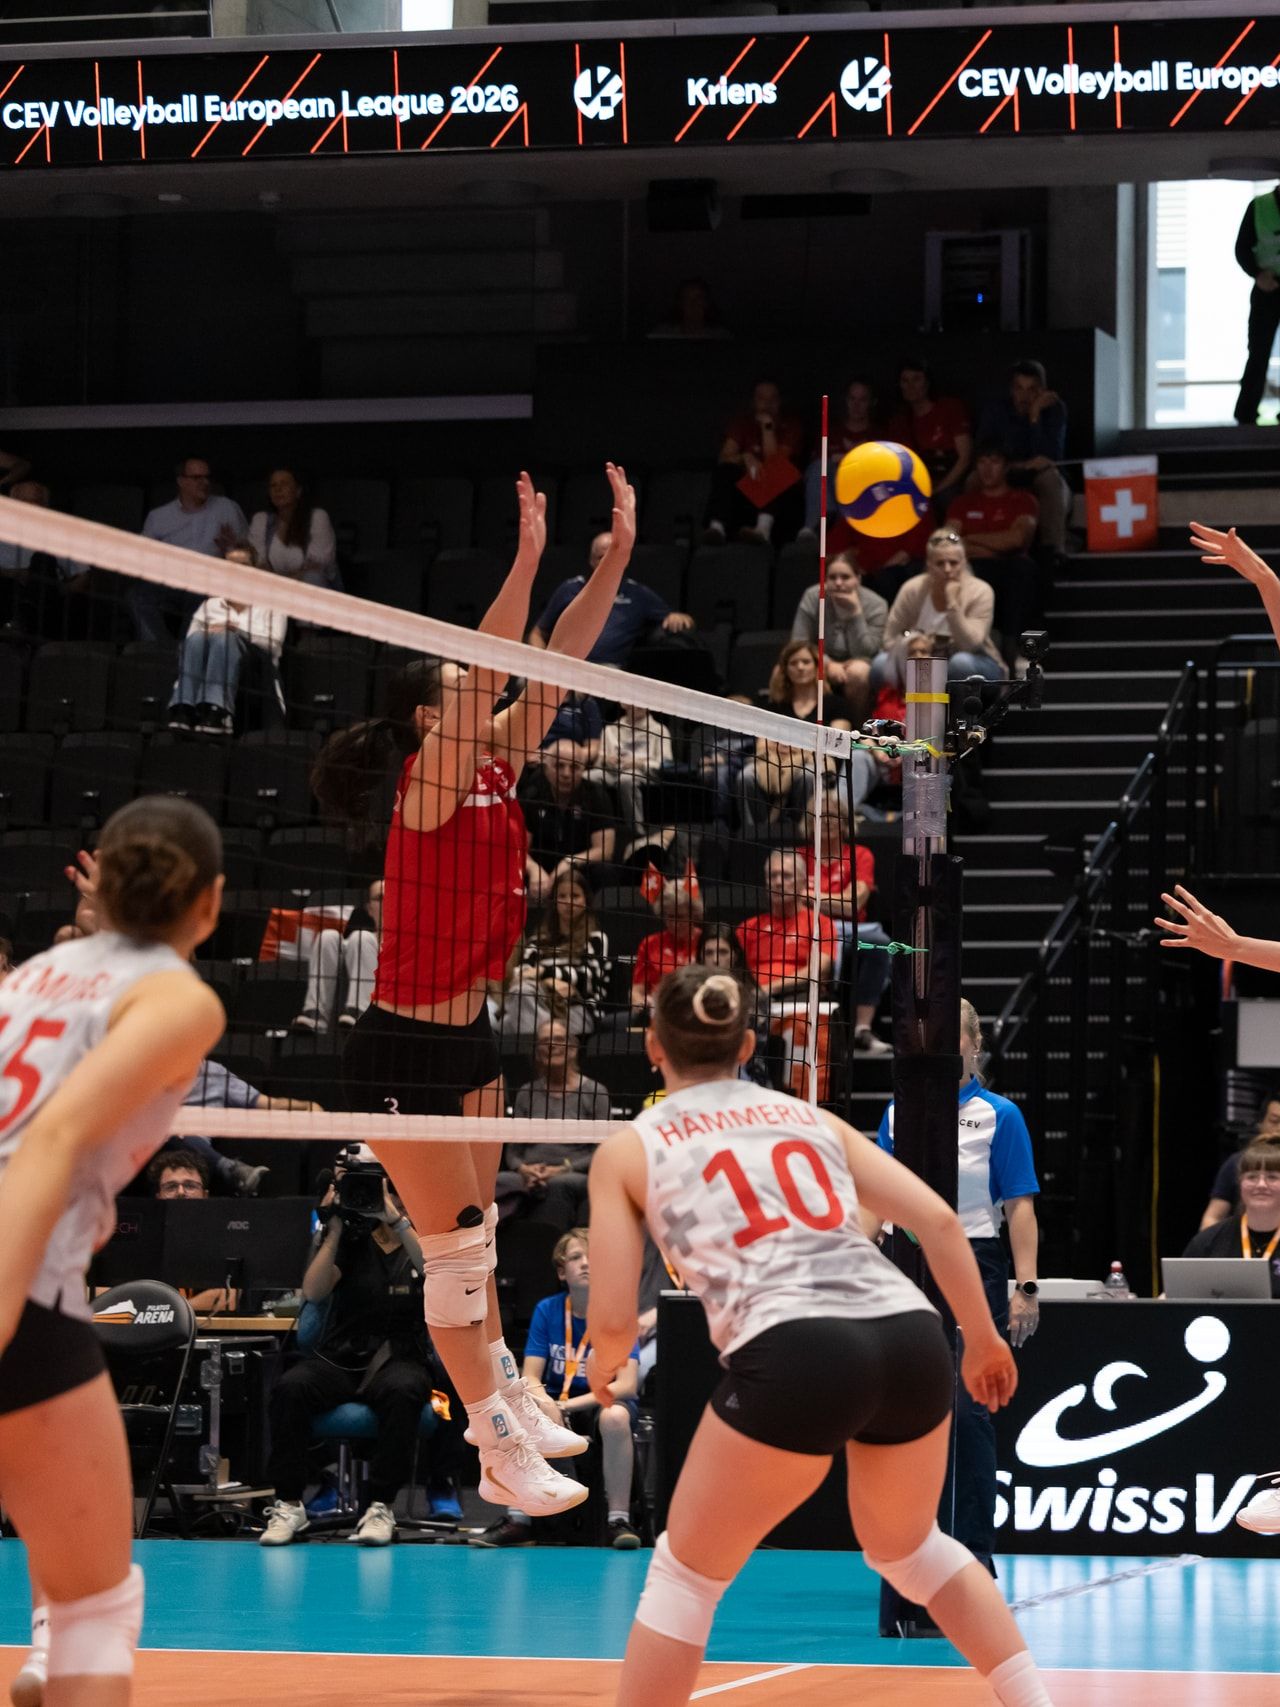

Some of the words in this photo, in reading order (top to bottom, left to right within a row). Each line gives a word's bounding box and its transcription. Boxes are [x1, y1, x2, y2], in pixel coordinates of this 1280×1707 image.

[687, 75, 778, 106] Kriens
[958, 68, 1021, 98] CEV
[1024, 60, 1169, 100] Volleyball
[2, 102, 60, 130] CEV
[64, 94, 198, 131] Volleyball
[204, 95, 336, 127] European
[341, 90, 444, 123] League
[449, 84, 519, 114] 2026
[656, 1103, 818, 1147] HÄMMERLI
[958, 1118, 981, 1129] CEV
[702, 1140, 845, 1249] 10
[134, 1310, 175, 1325] ARENA
